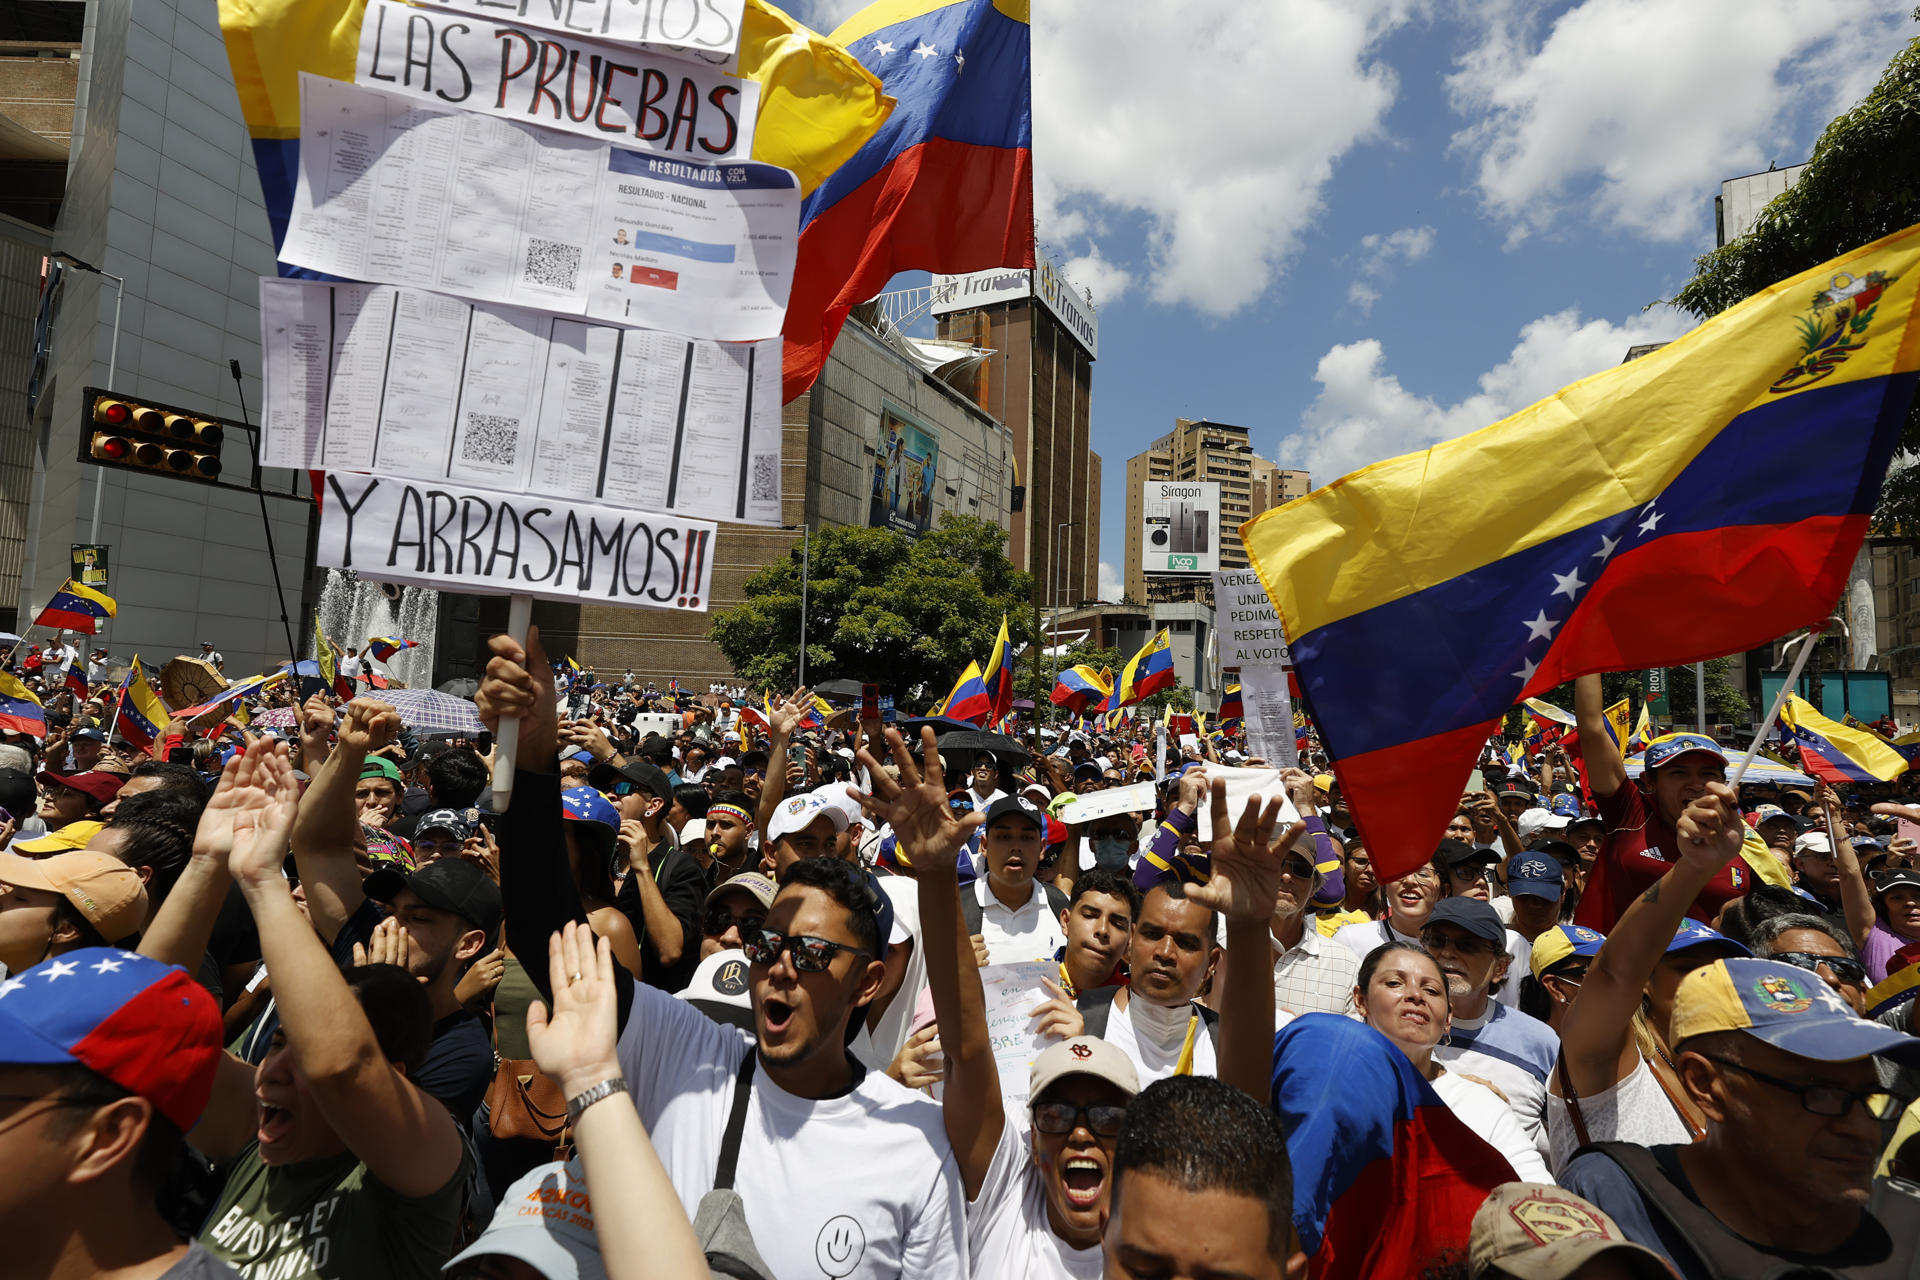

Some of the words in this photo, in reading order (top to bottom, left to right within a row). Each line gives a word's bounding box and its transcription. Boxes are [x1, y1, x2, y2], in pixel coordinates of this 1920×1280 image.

[369, 5, 473, 103] LAS
[494, 28, 740, 155] PRUEBAS
[649, 160, 722, 183] RESULTADOS
[726, 174, 747, 182] VZLA
[728, 167, 745, 176] CON
[618, 184, 664, 200] RESULTADOS
[670, 194, 707, 209] NACIONAL
[1056, 278, 1094, 347] Tramas
[326, 473, 379, 568] Y
[386, 484, 710, 609] ARRASAMOS!!
[1220, 574, 1260, 587] VENEZ
[1238, 593, 1270, 606] UNID
[1231, 609, 1280, 622] PEDIMO
[1236, 649, 1251, 660] AL
[1253, 647, 1290, 660] VOTO
[518, 1205, 569, 1220] CARACAS
